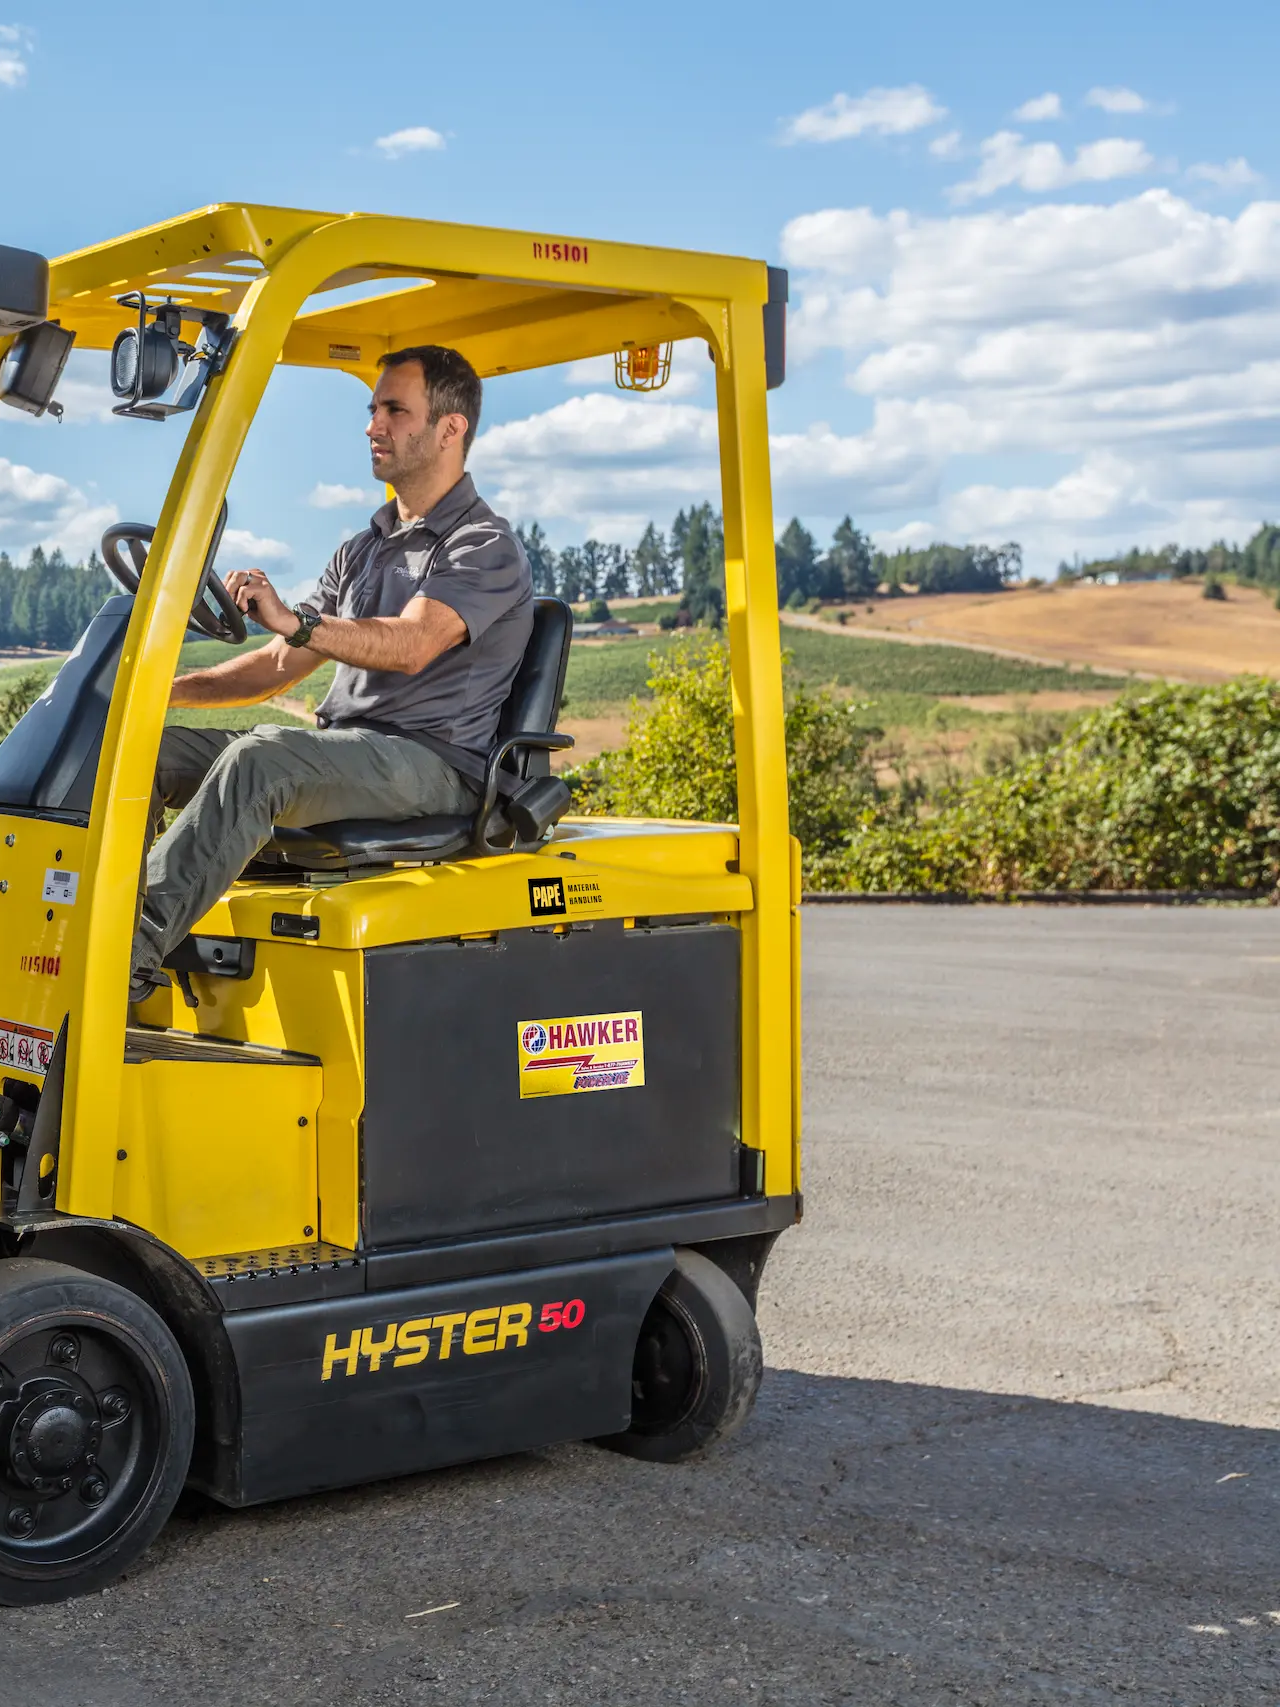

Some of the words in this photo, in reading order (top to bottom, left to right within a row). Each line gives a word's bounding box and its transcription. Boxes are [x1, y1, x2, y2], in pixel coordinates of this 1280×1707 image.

[567, 883, 600, 893] MATERIAL
[569, 895, 602, 905] HANDLING
[549, 1019, 638, 1050] HAWKER
[574, 1071, 630, 1089] POWERLINE
[321, 1302, 532, 1381] HYSTER
[538, 1298, 585, 1333] 50
